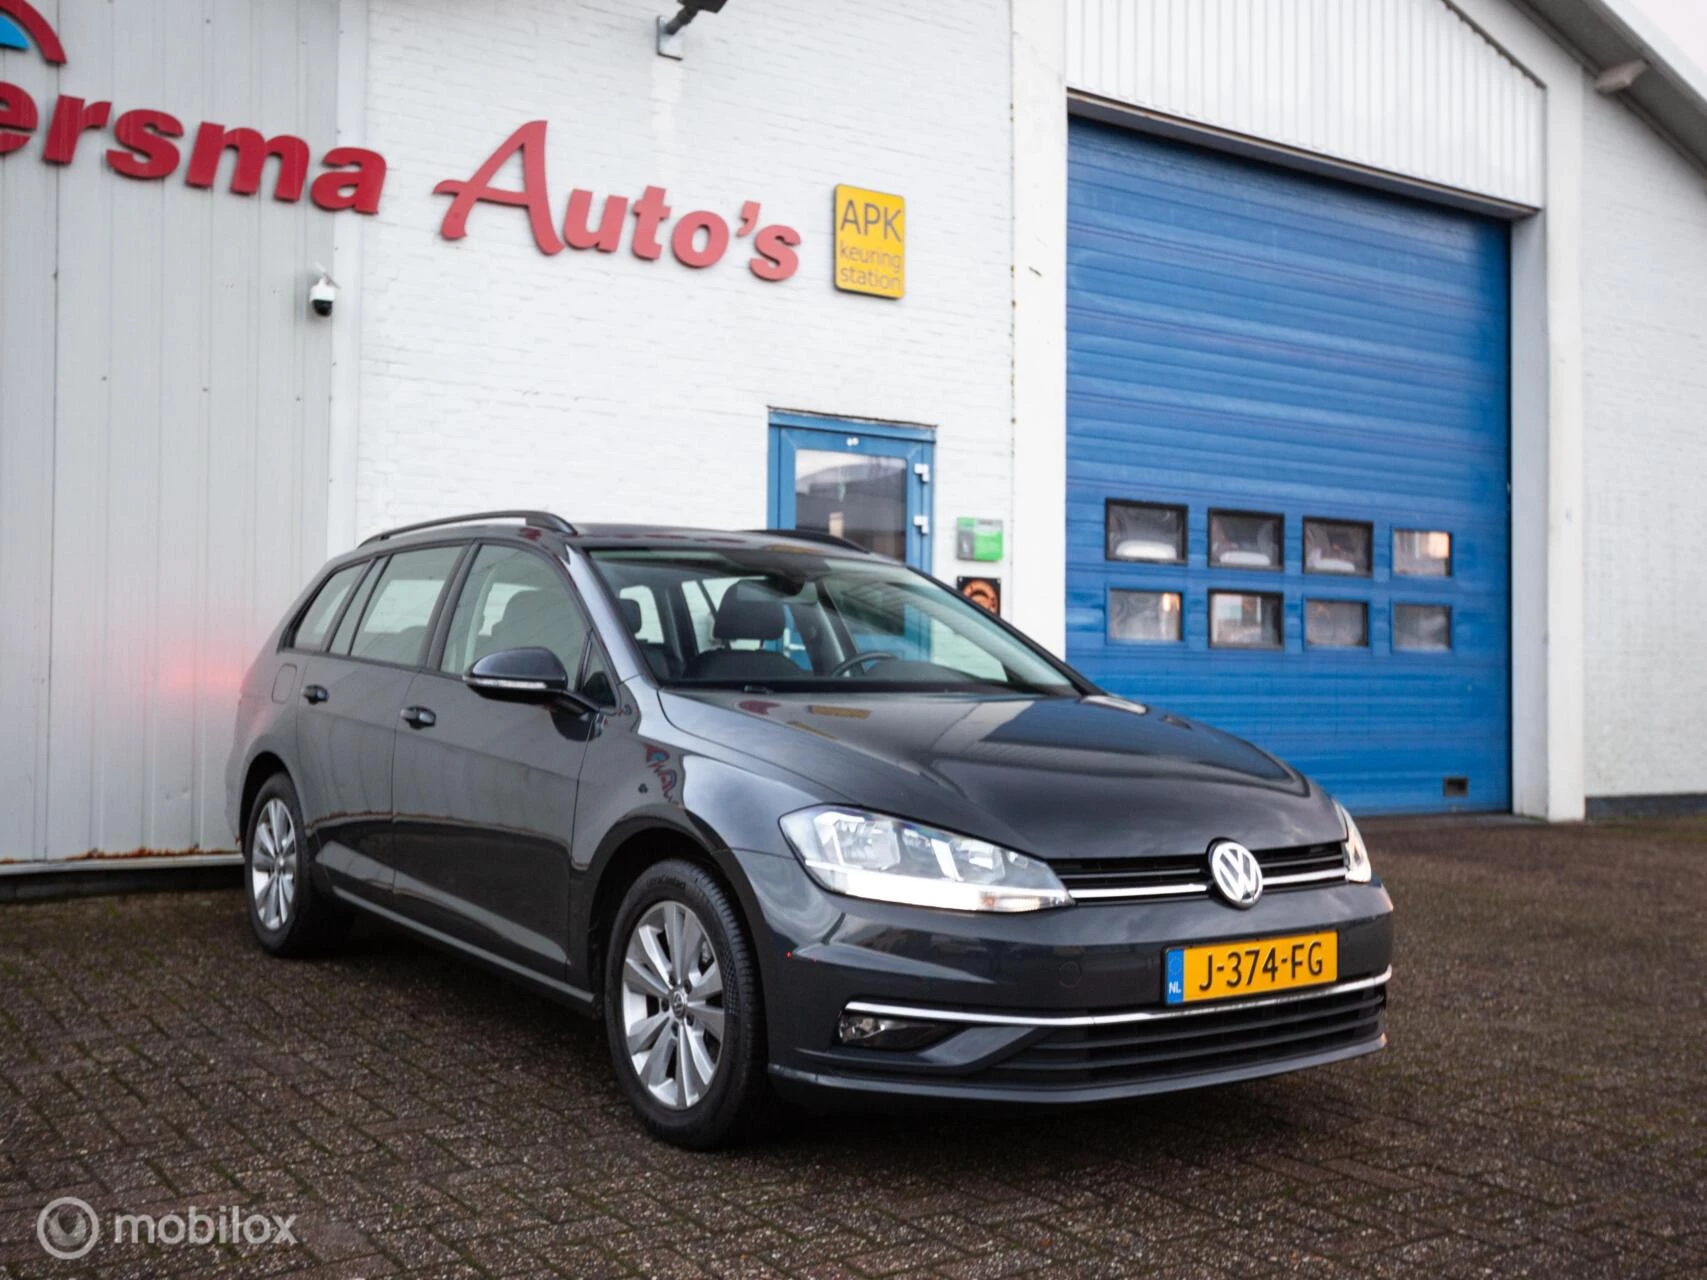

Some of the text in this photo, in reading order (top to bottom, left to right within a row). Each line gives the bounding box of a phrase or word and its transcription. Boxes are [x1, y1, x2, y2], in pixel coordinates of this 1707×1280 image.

[432, 120, 801, 282] Auto's
[840, 199, 902, 243] APK
[839, 240, 901, 273] keuring
[839, 266, 901, 290] station
[1199, 941, 1323, 992] J-374-FG
[1168, 982, 1182, 994] NL
